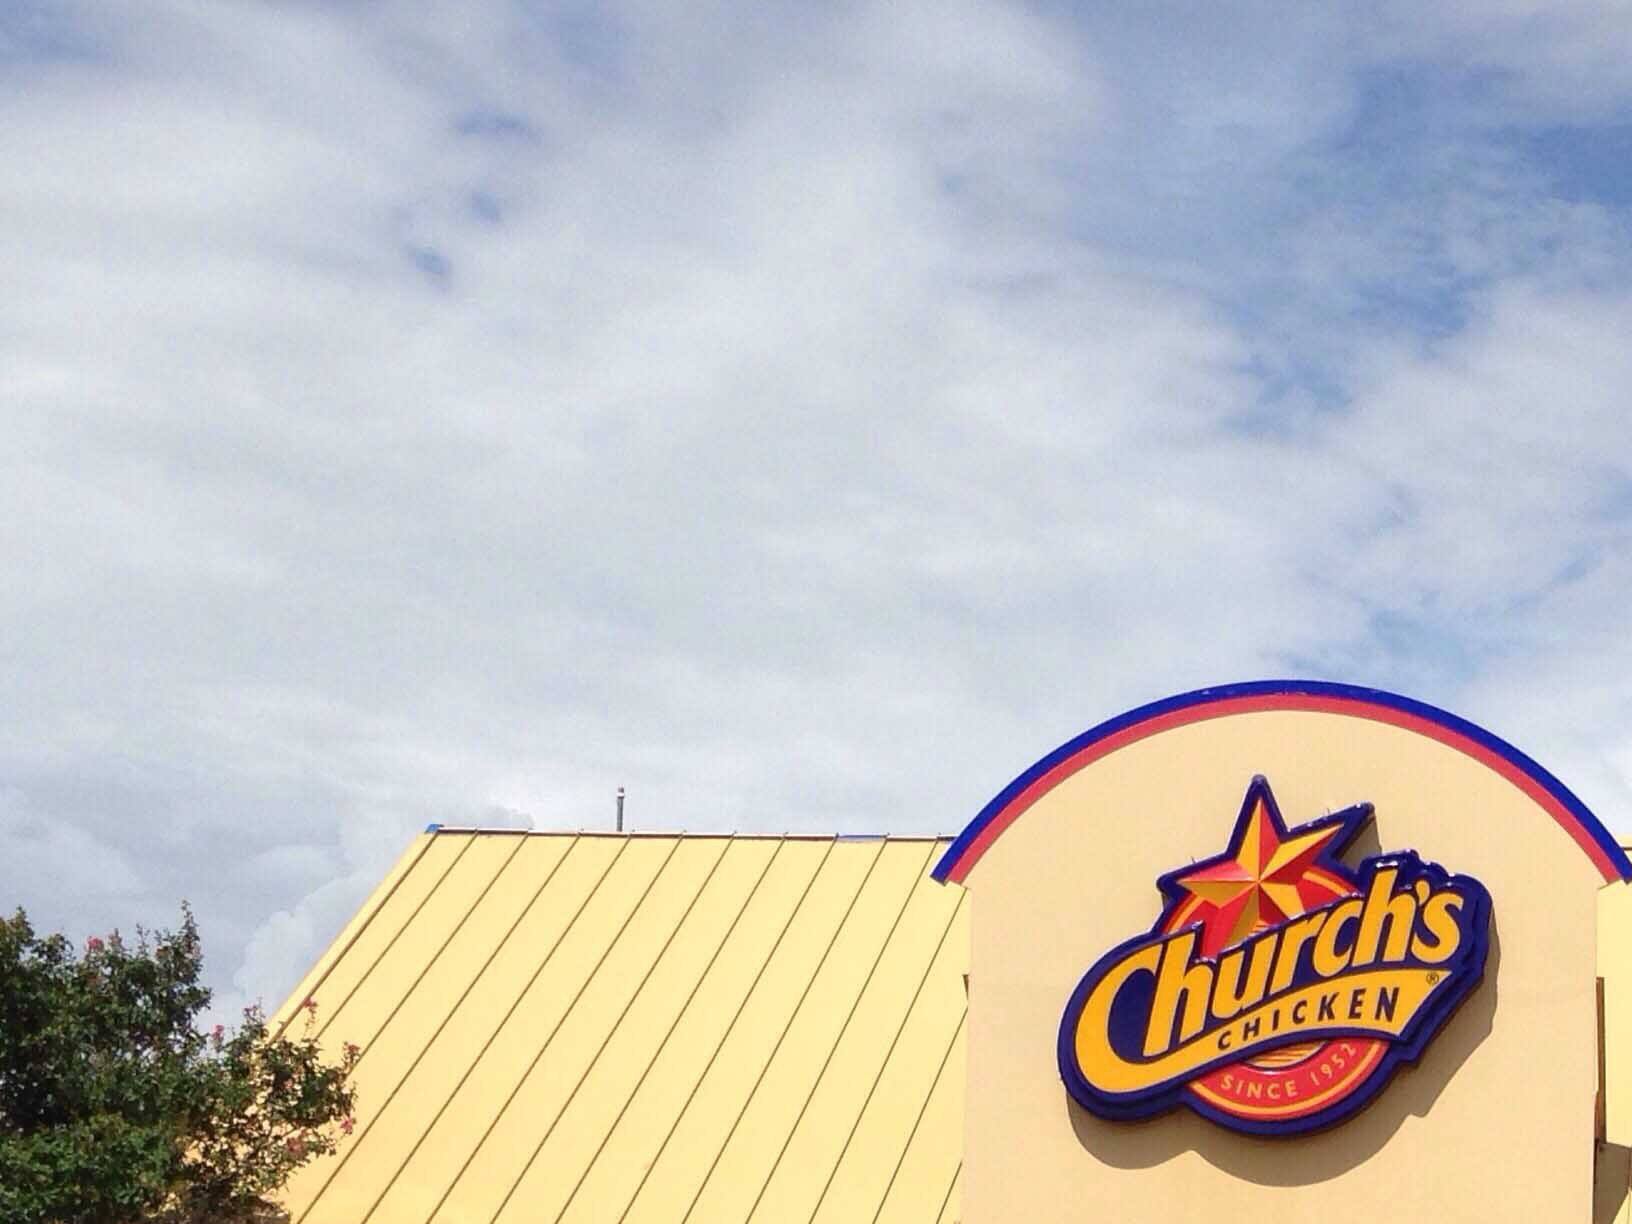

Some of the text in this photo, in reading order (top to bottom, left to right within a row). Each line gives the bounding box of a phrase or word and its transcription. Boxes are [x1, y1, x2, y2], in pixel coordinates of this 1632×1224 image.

[1075, 865, 1464, 1093] Church's
[1217, 987, 1400, 1051] CHICKEN
[1220, 1043, 1356, 1100] SINCE 1952
